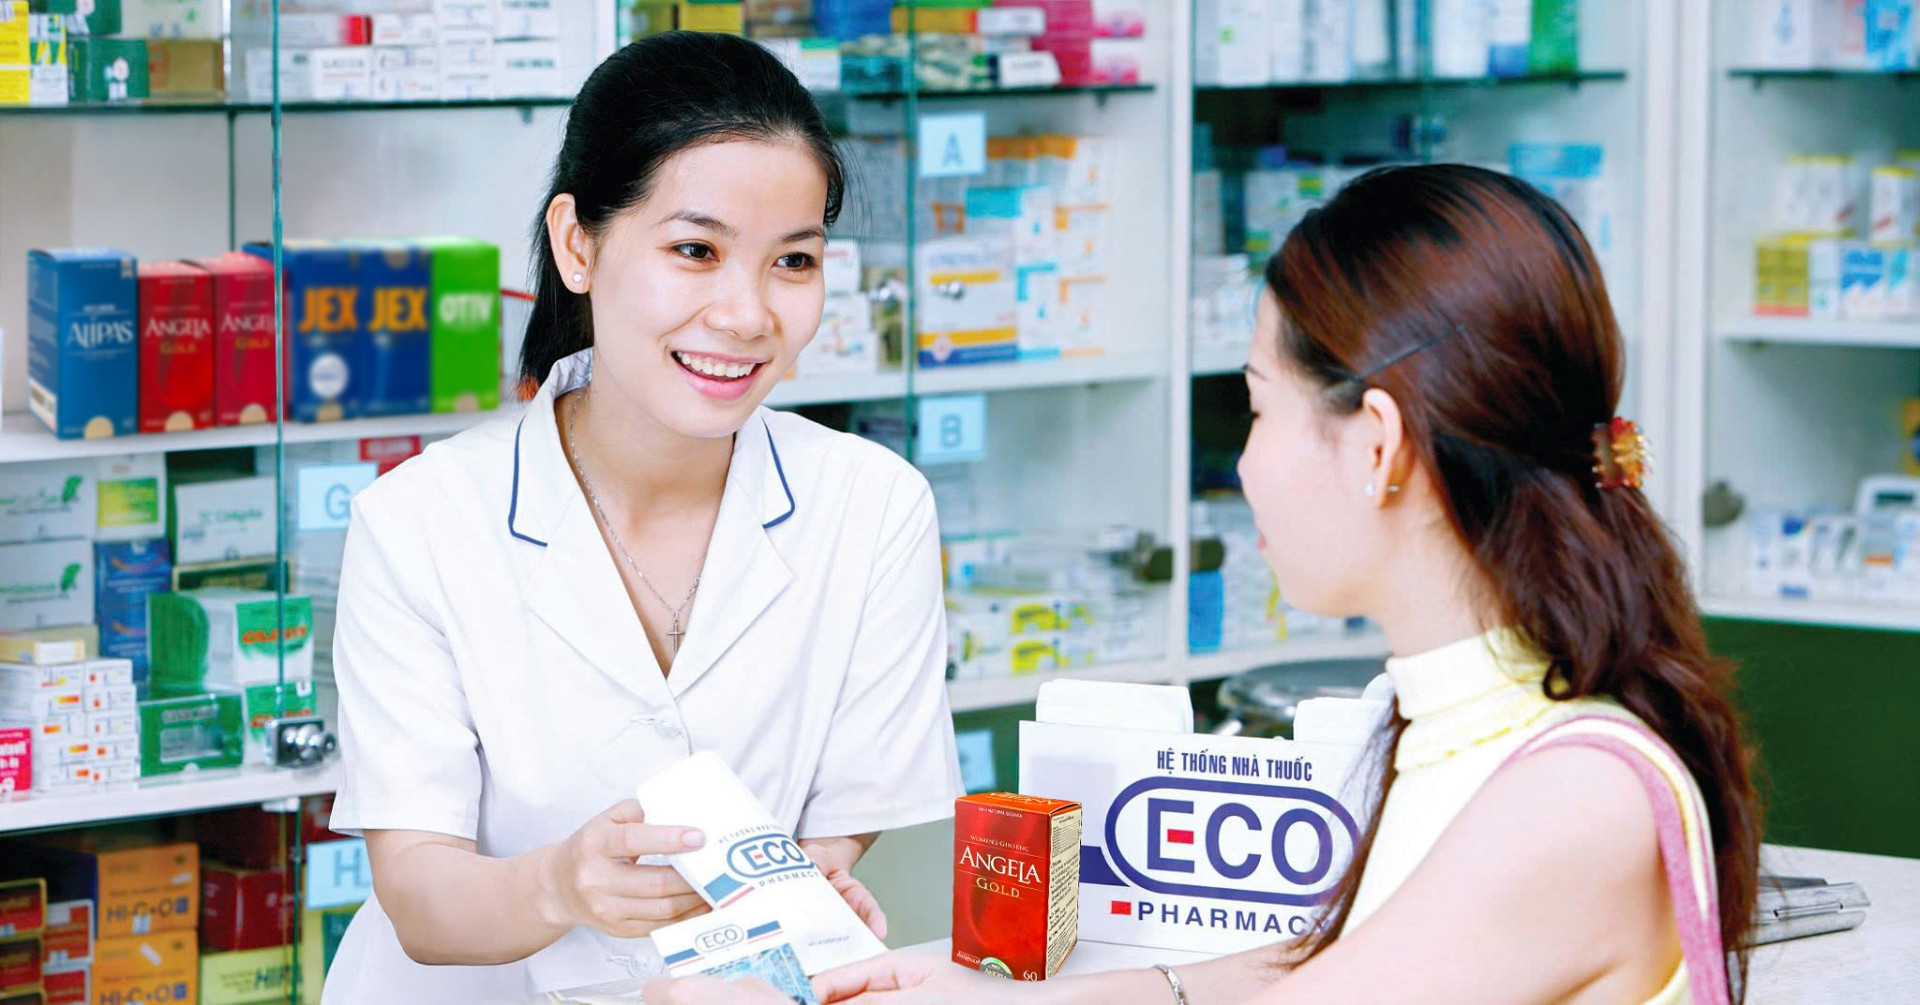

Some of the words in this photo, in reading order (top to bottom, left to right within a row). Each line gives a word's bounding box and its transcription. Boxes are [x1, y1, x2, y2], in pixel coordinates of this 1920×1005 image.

[941, 132, 963, 167] A
[299, 288, 358, 332] JEX
[368, 287, 428, 332] JEX
[145, 317, 211, 339] ANGELA
[941, 413, 962, 449] B
[324, 484, 352, 520] G
[1157, 747, 1175, 775] HỆ
[1181, 749, 1227, 775] THỐNG
[1232, 754, 1260, 777] NHÀ
[1266, 757, 1313, 782] THUỐC
[740, 839, 806, 871] ECO
[1147, 797, 1334, 886] ECO
[959, 845, 1042, 885] ANGELA
[976, 877, 1020, 899] GOLD
[1138, 901, 1331, 937] PHARMAC
[701, 928, 739, 949] ECO
[1022, 969, 1038, 981] 60
